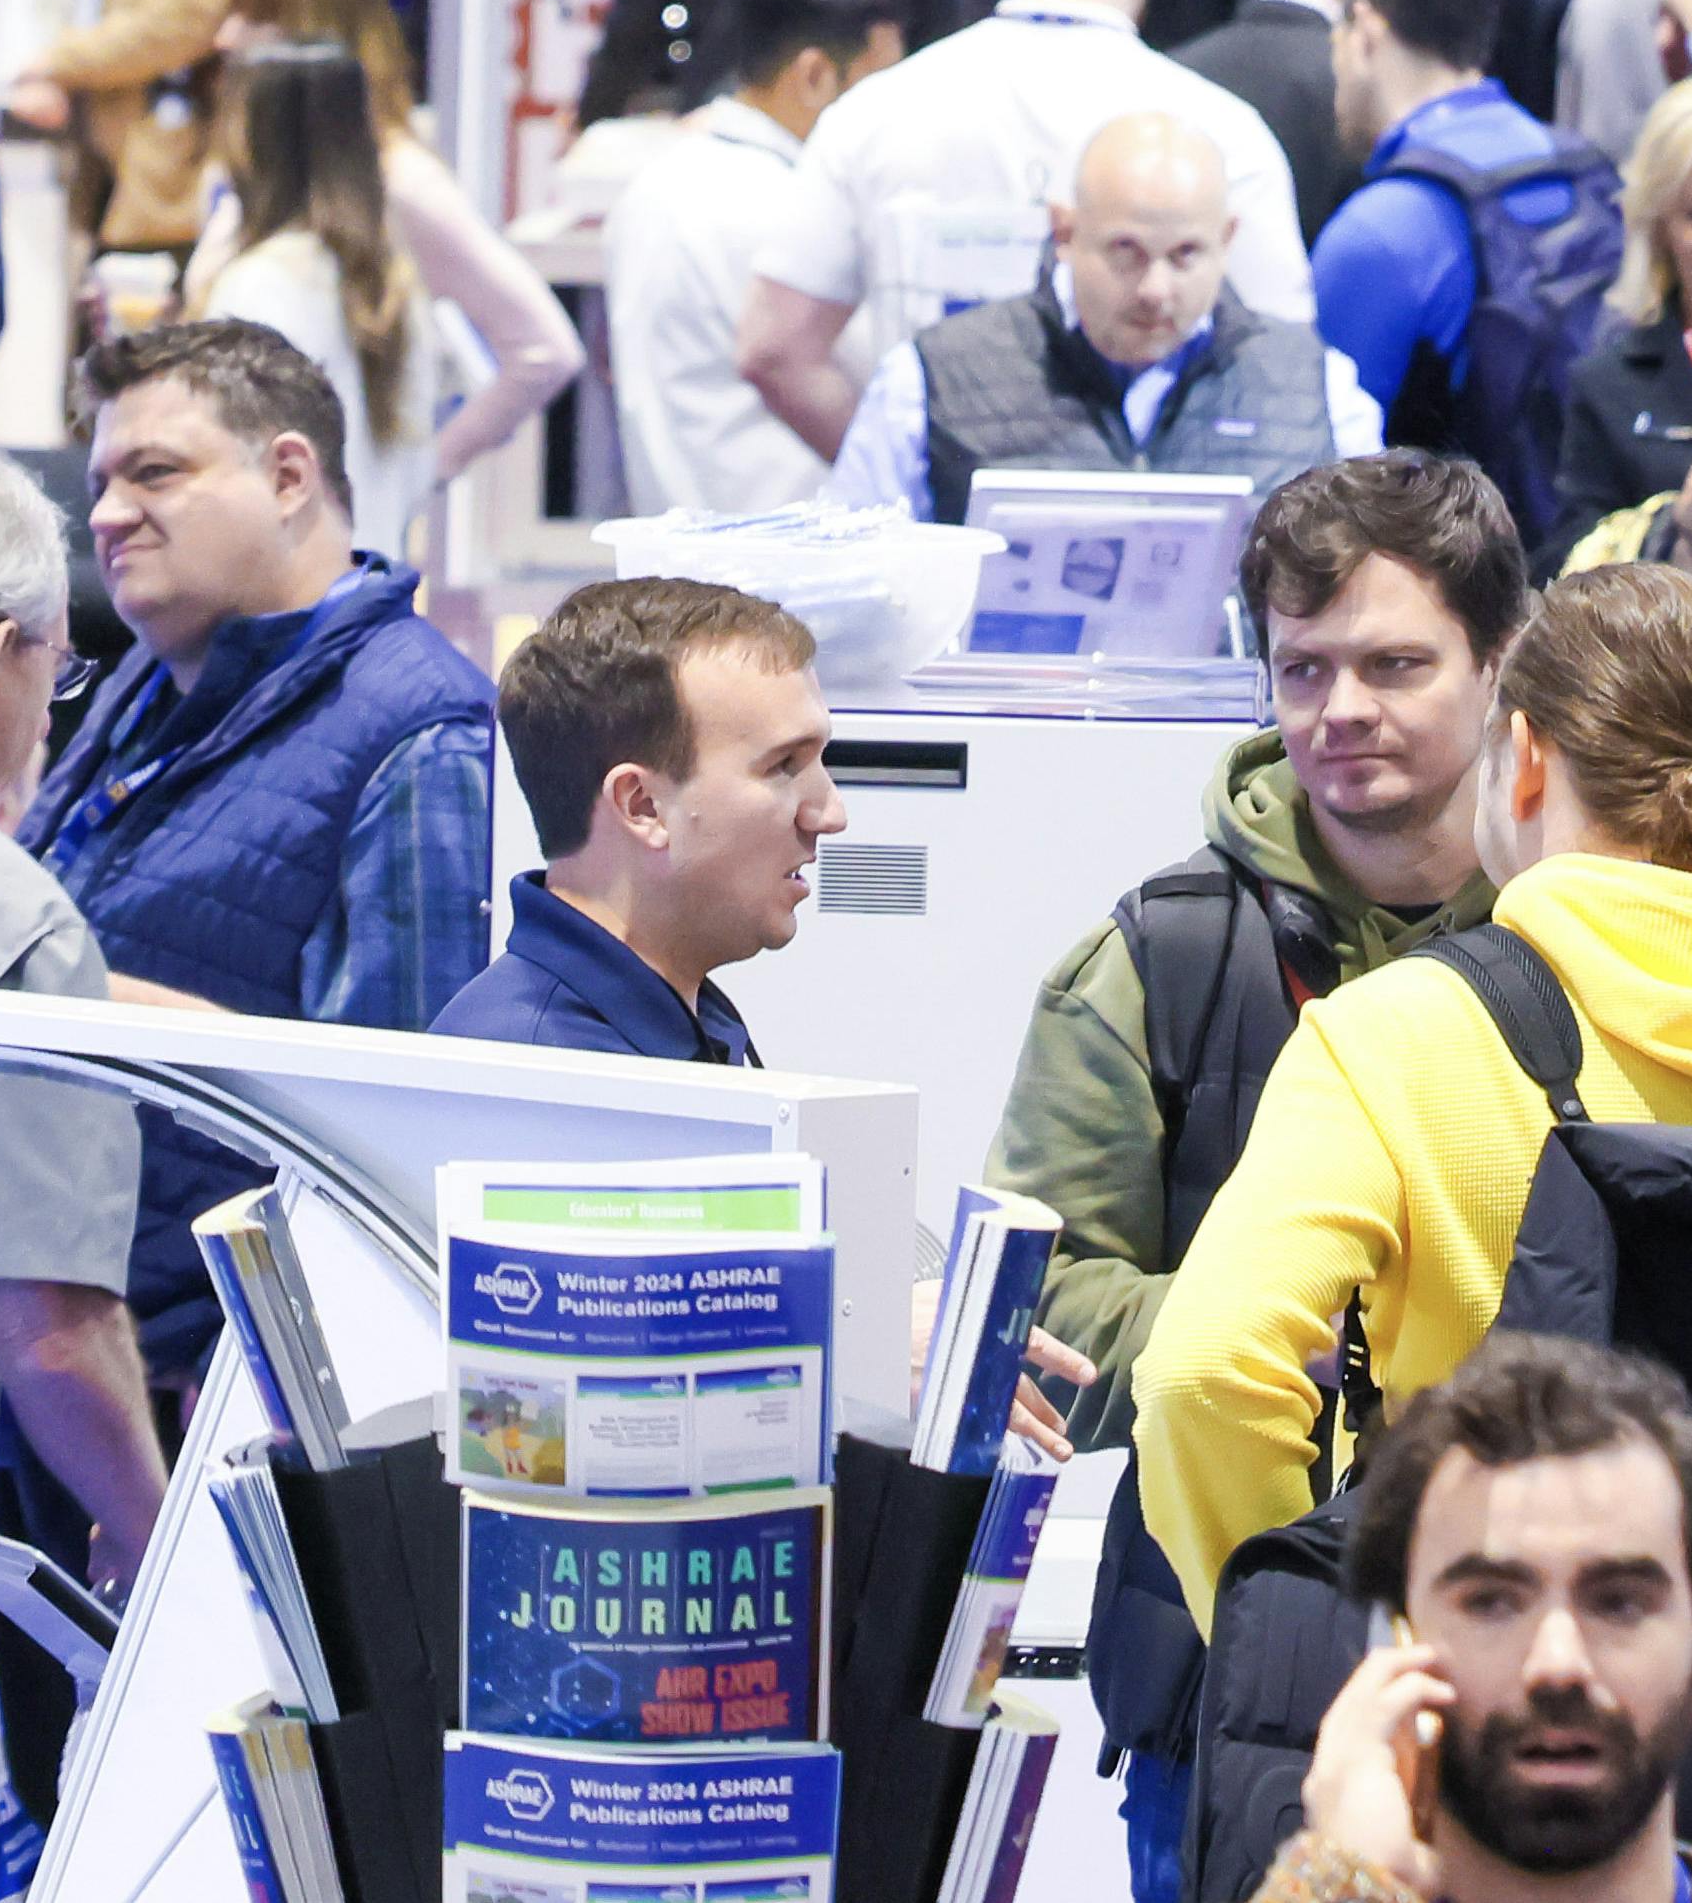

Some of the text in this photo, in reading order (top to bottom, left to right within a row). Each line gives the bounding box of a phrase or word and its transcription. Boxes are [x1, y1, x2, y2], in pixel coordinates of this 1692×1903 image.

[569, 1201, 704, 1221] Educators' Resources
[475, 1274, 530, 1301] ASHRAE
[556, 1266, 782, 1293] Winter 2024 ASHRAE
[556, 1291, 779, 1317] Publications Catalog
[552, 1541, 795, 1586] ASHRAE
[510, 1590, 794, 1637] JOURNAL
[655, 1659, 778, 1699] AHR EXPO
[639, 1692, 790, 1736] SHOW ISSUE
[486, 1778, 543, 1807] ASHRAE
[570, 1776, 794, 1802] Winter 2024 ASHRAE
[569, 1802, 790, 1826] Publications Catalog
